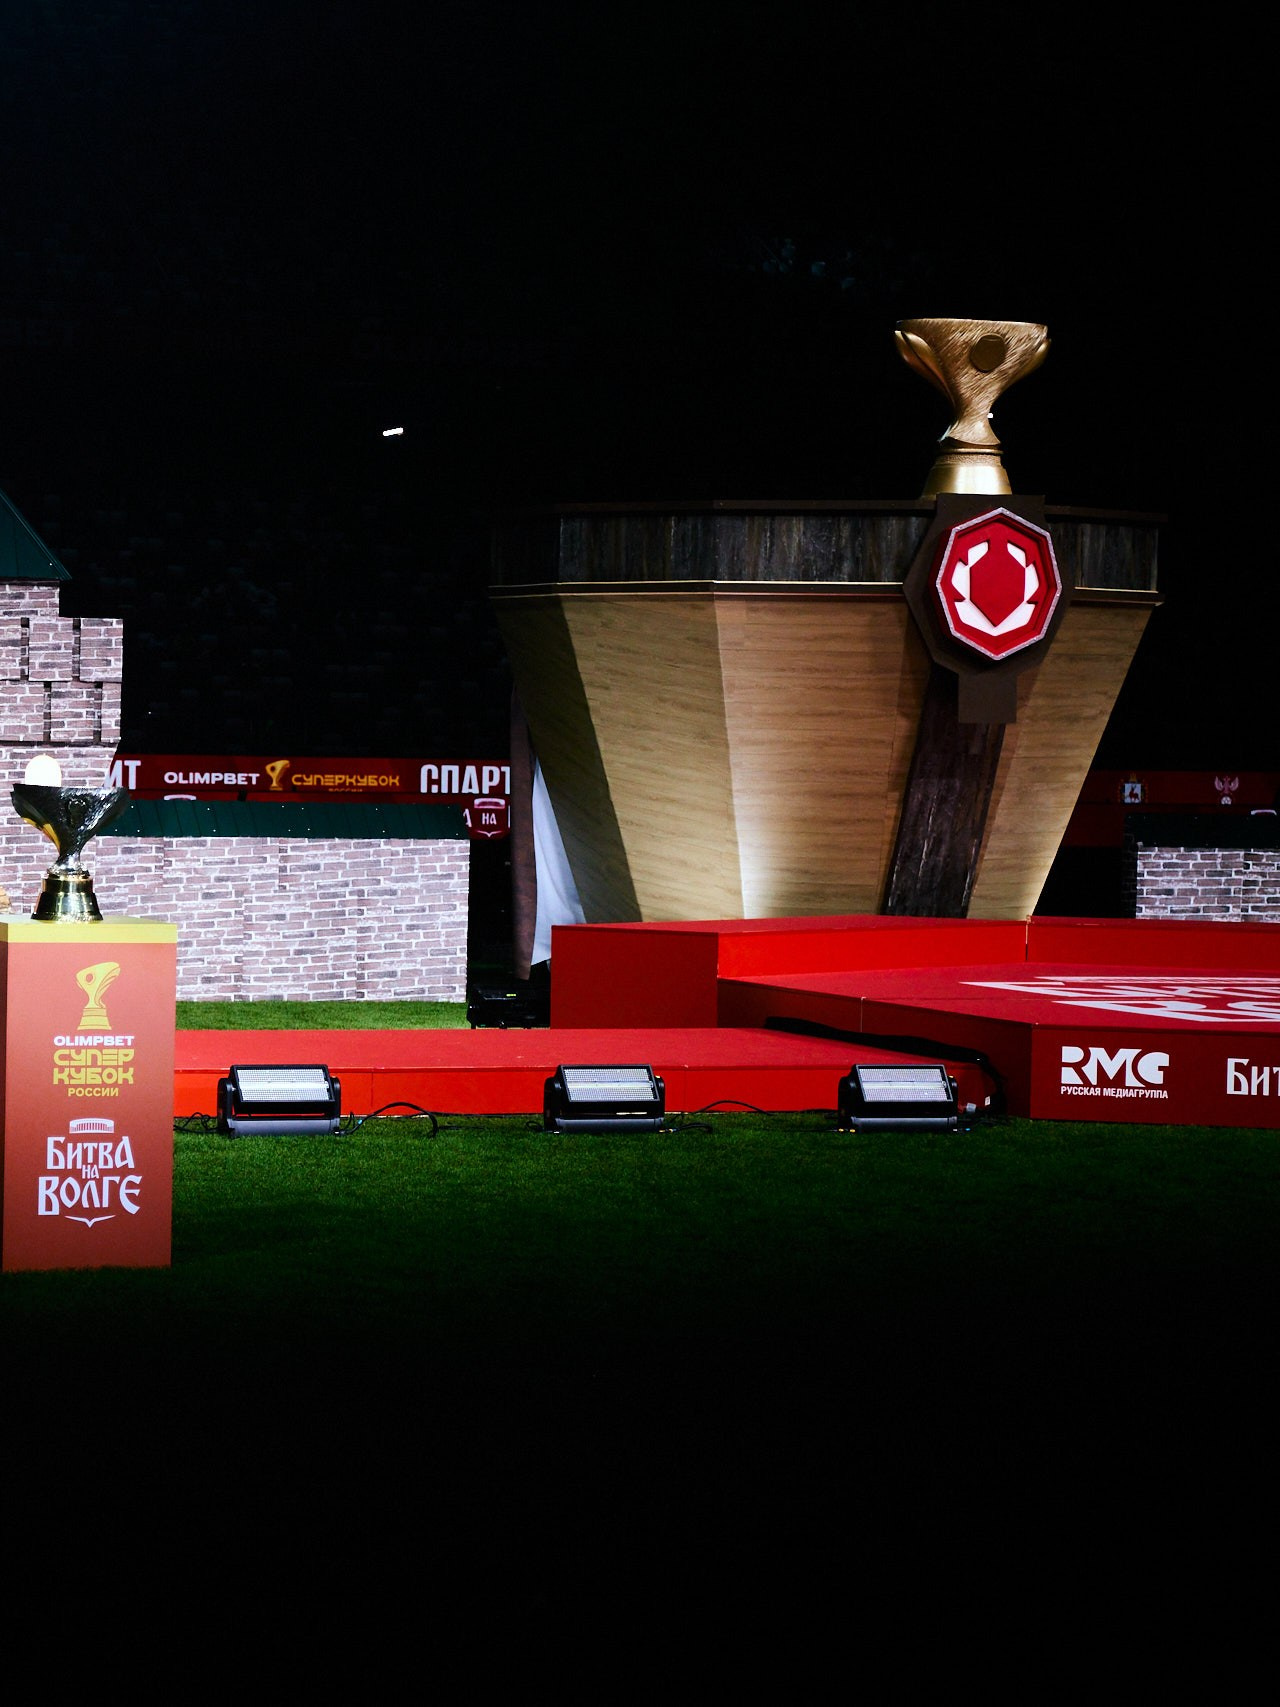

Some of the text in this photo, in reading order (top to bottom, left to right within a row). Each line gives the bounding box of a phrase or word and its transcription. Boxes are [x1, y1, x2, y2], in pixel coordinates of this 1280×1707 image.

[163, 770, 261, 786] OLIMPBET
[291, 774, 401, 787] СУПЕРКУБОК
[54, 1035, 135, 1047] OLIMPBET
[53, 1049, 135, 1066] СУПЕР
[1060, 1045, 1170, 1088] RMG
[52, 1067, 134, 1085] КУБОК
[67, 1087, 120, 1097] РОССИИ
[1060, 1085, 1169, 1099] РУССКАЯ МЕДИАГРУППА
